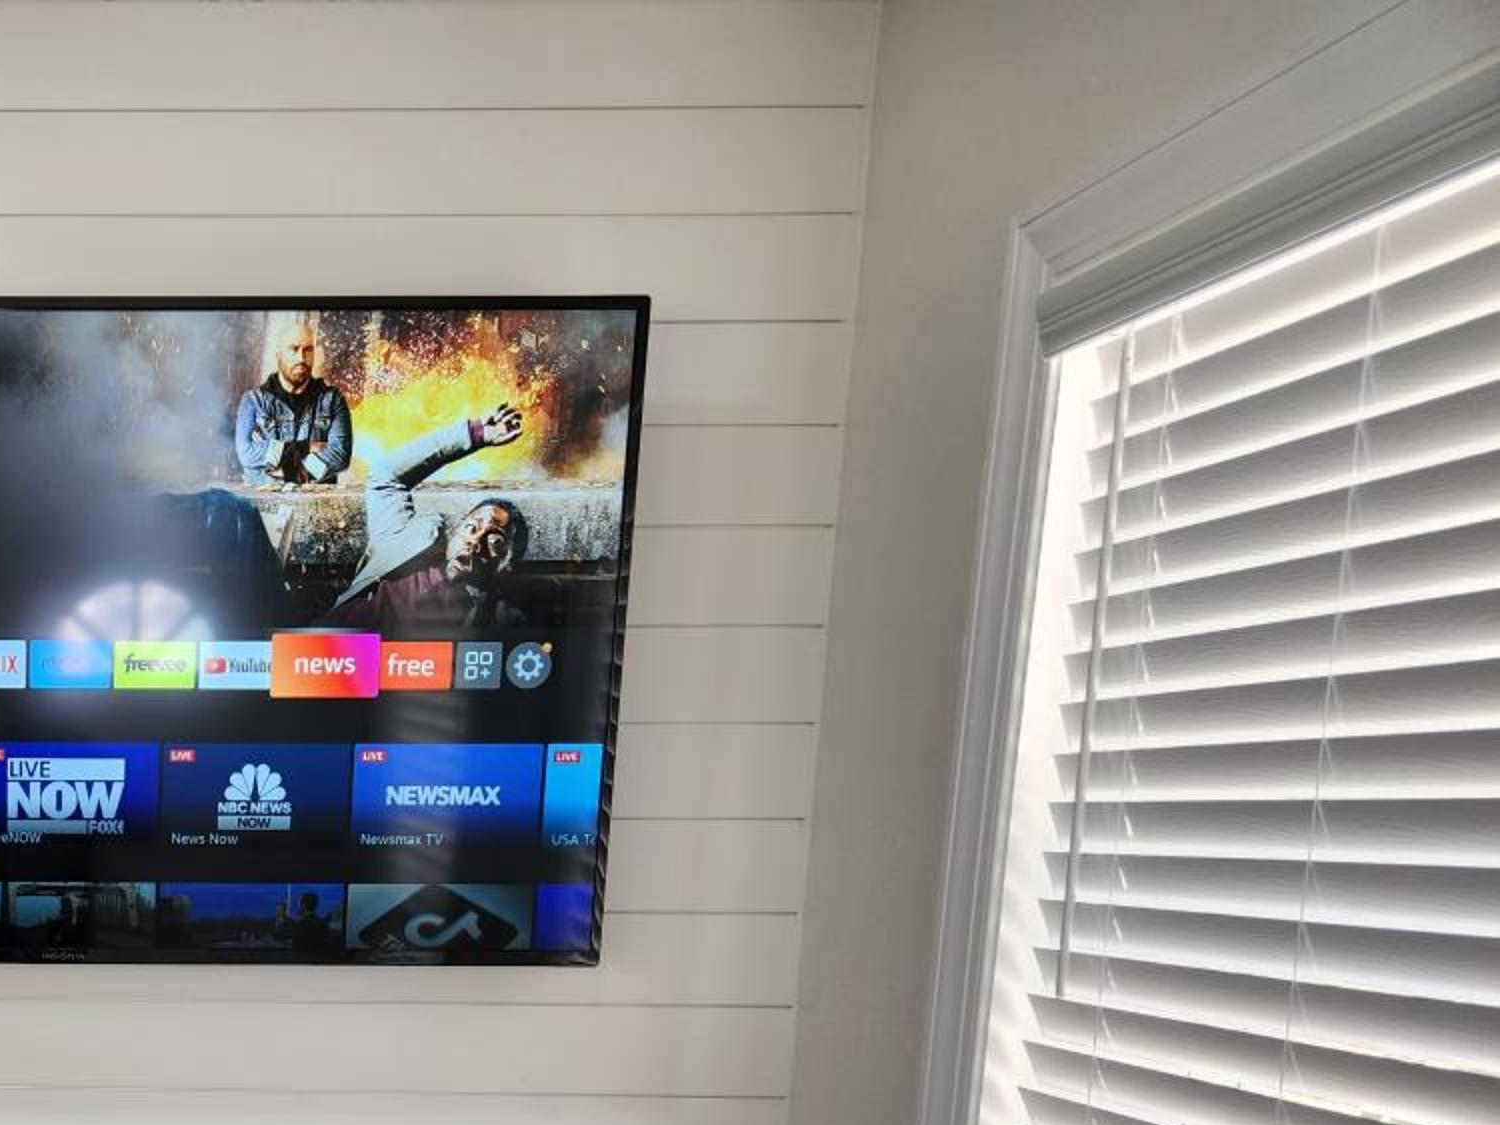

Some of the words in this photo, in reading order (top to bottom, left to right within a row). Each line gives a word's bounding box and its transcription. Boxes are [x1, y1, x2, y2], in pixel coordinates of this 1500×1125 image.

[294, 655, 357, 676] news
[387, 653, 436, 677] free
[170, 750, 194, 762] LIVE
[362, 751, 384, 761] LIVE
[555, 752, 578, 763] LIVE
[9, 761, 51, 778] LIVE
[7, 781, 125, 819] NOW
[386, 785, 501, 806] NEWSMAX
[217, 802, 247, 814] NBC
[251, 802, 292, 814] NEWS
[237, 818, 271, 828] NOW
[171, 832, 206, 845] News
[209, 832, 239, 845] Now
[361, 833, 422, 846] Newsmax
[426, 833, 443, 845] TV
[551, 833, 579, 846] USA
